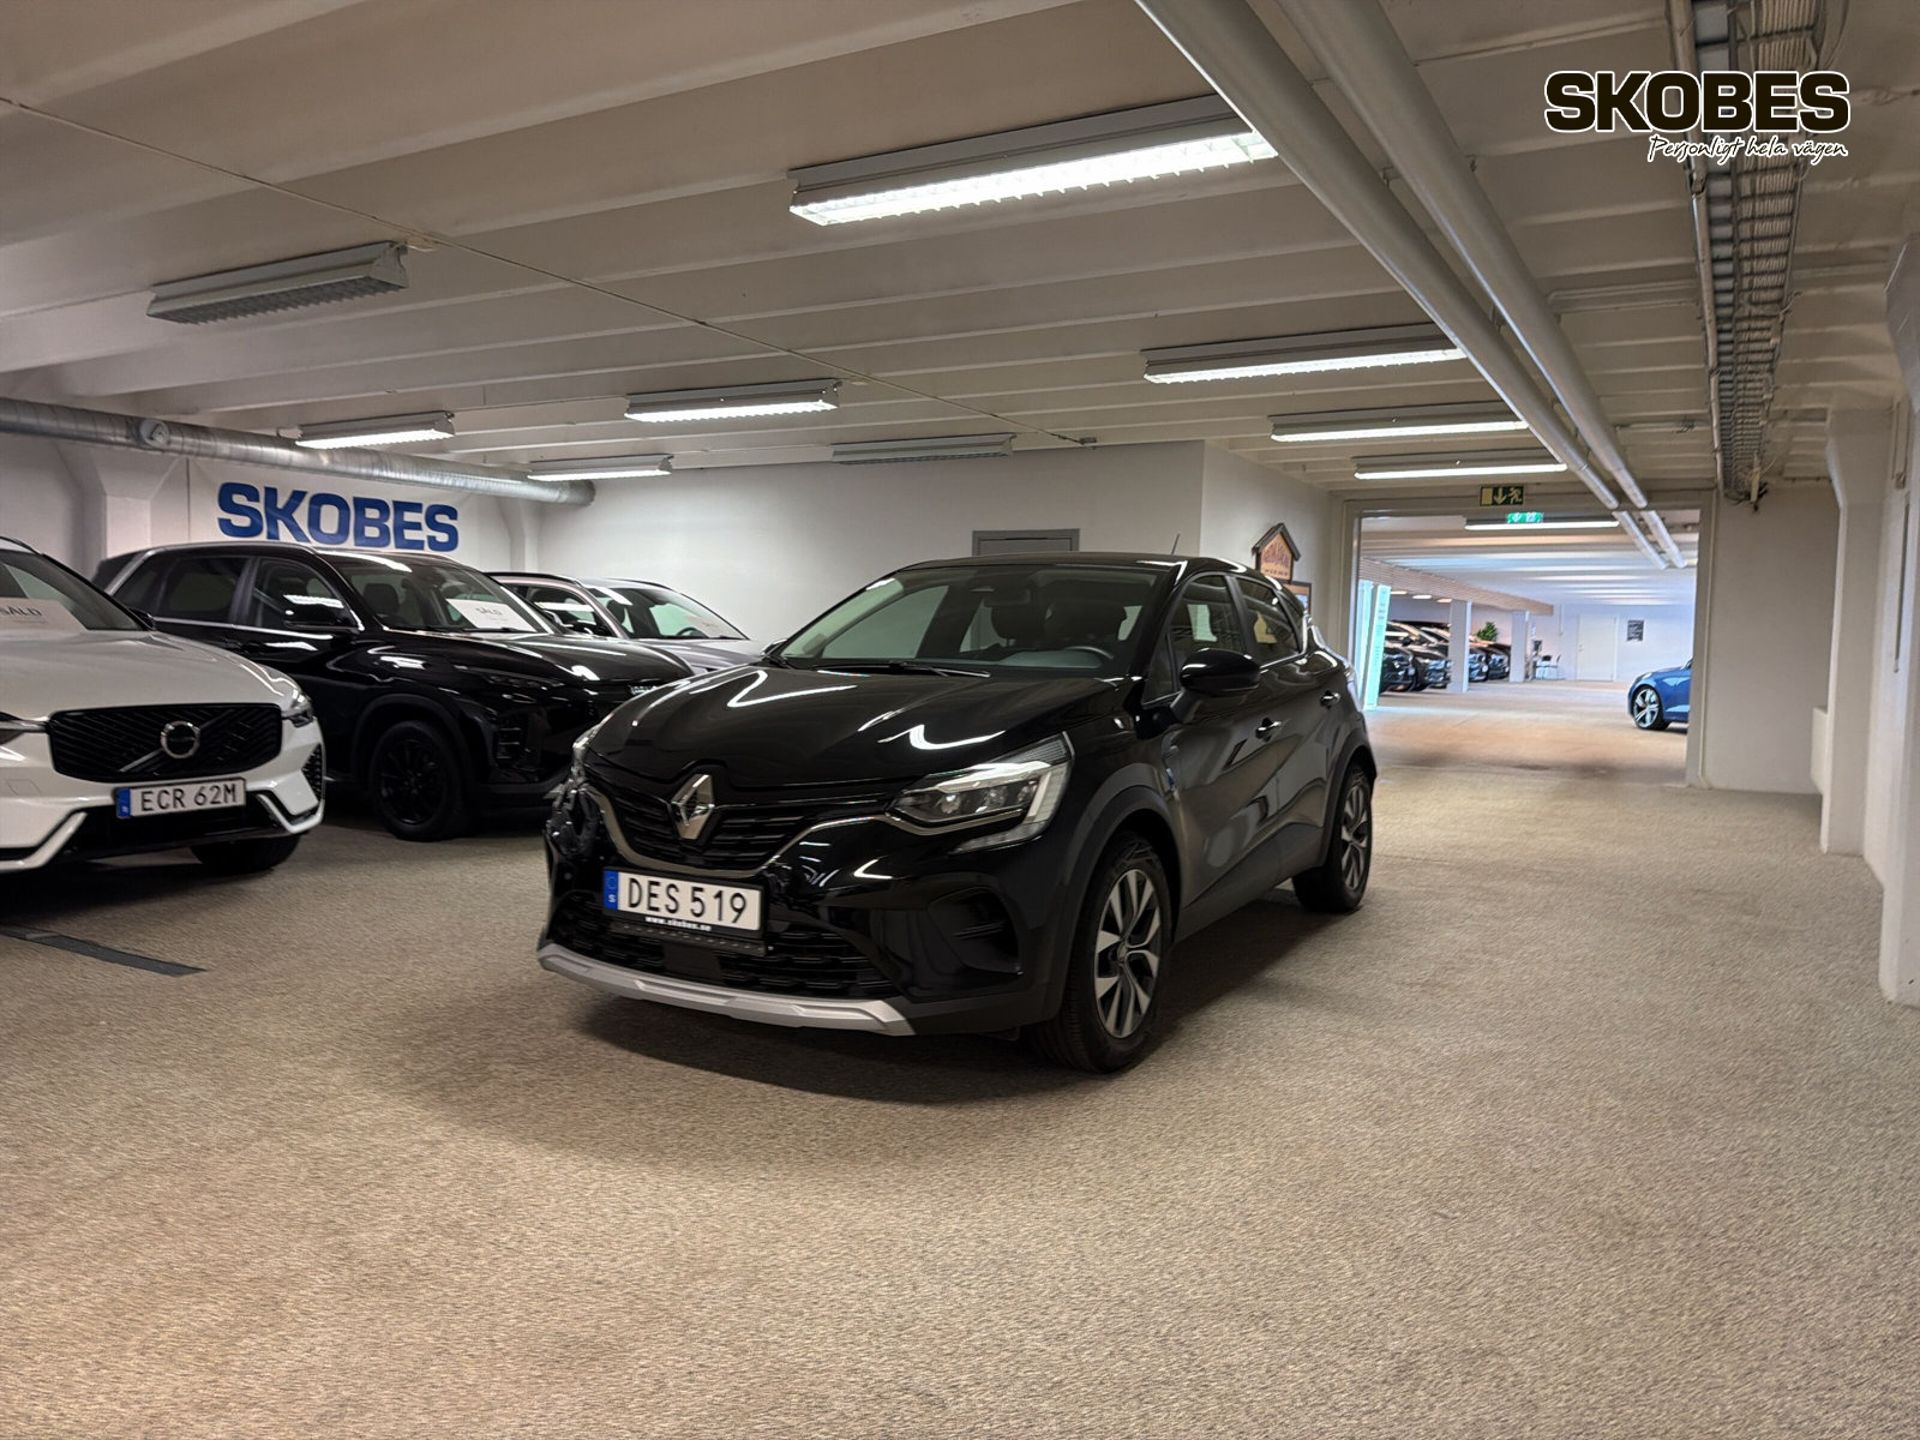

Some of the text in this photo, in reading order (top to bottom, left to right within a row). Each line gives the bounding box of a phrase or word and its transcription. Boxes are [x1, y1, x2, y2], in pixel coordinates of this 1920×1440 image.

[217, 481, 459, 552] SKOBES
[141, 783, 237, 812] ECR 62M
[608, 894, 617, 903] S
[628, 877, 747, 924] DES 519
